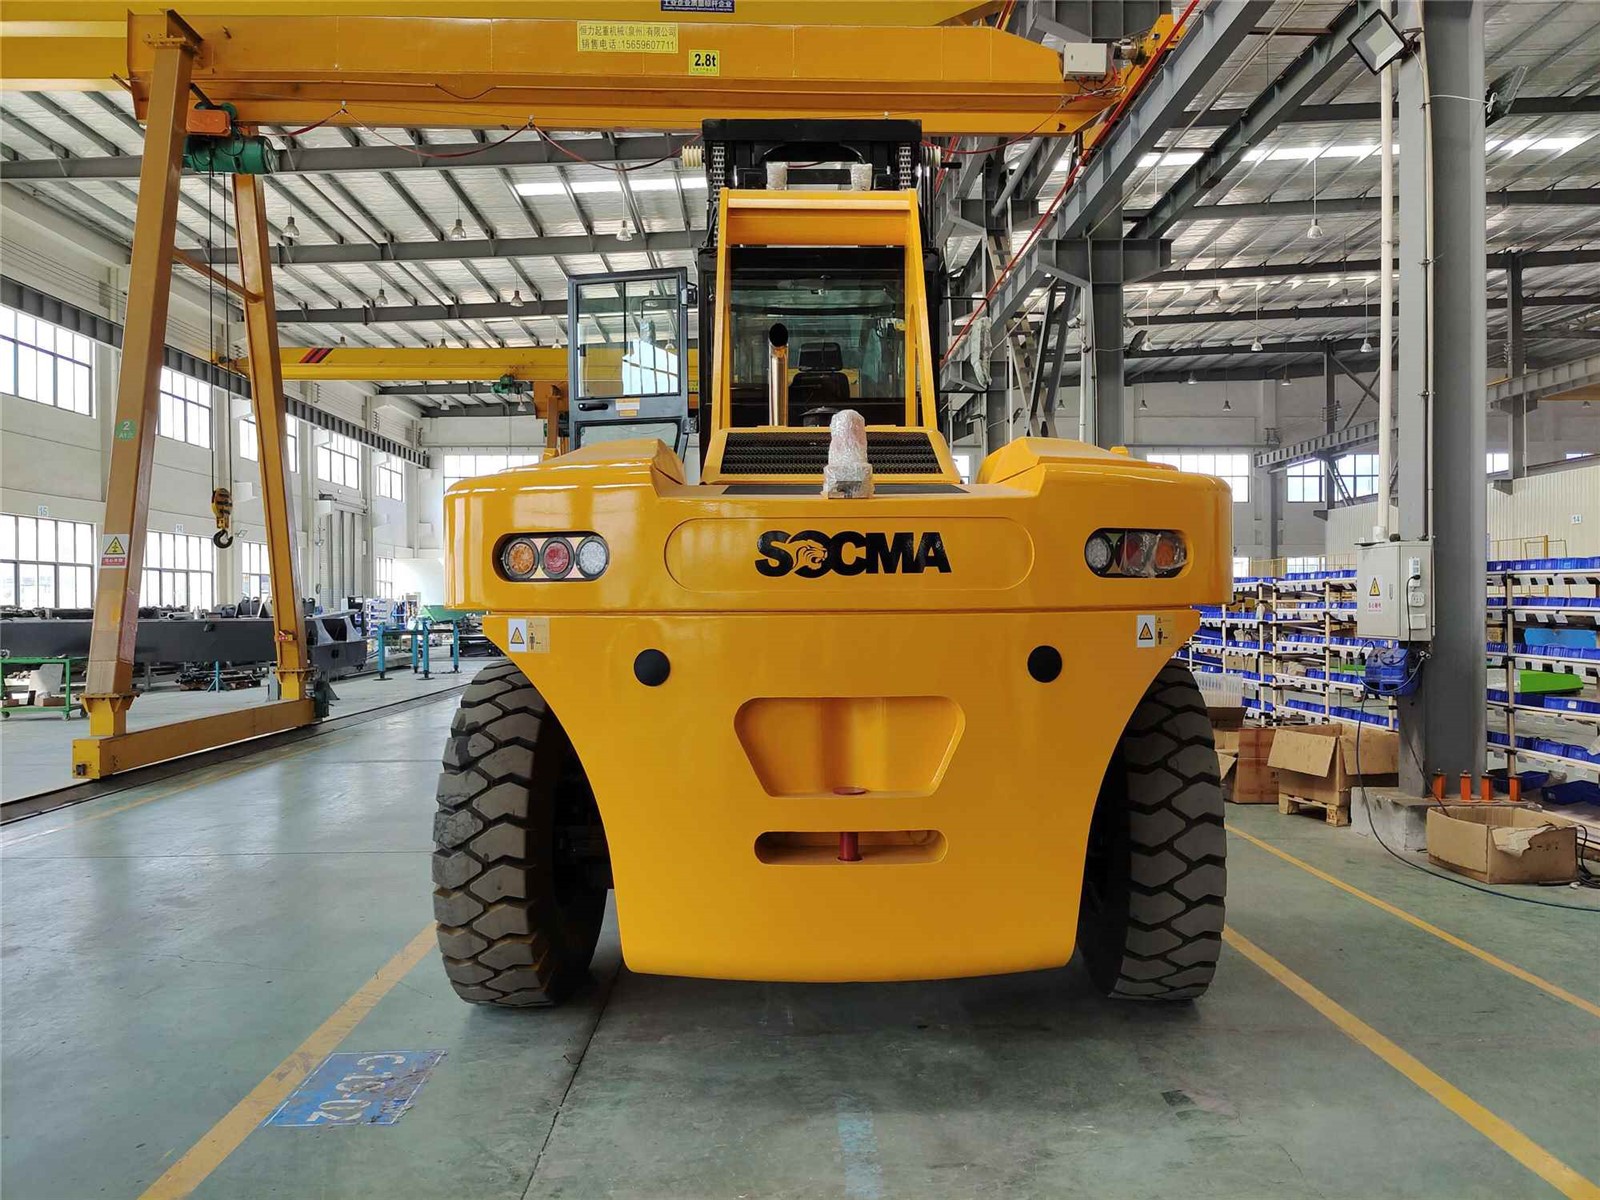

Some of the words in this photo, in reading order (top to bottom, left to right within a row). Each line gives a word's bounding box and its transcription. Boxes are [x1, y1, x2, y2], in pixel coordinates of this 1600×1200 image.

[694, 53, 716, 67] 2.8t
[122, 421, 130, 431] 2
[755, 530, 952, 578] SOCMA
